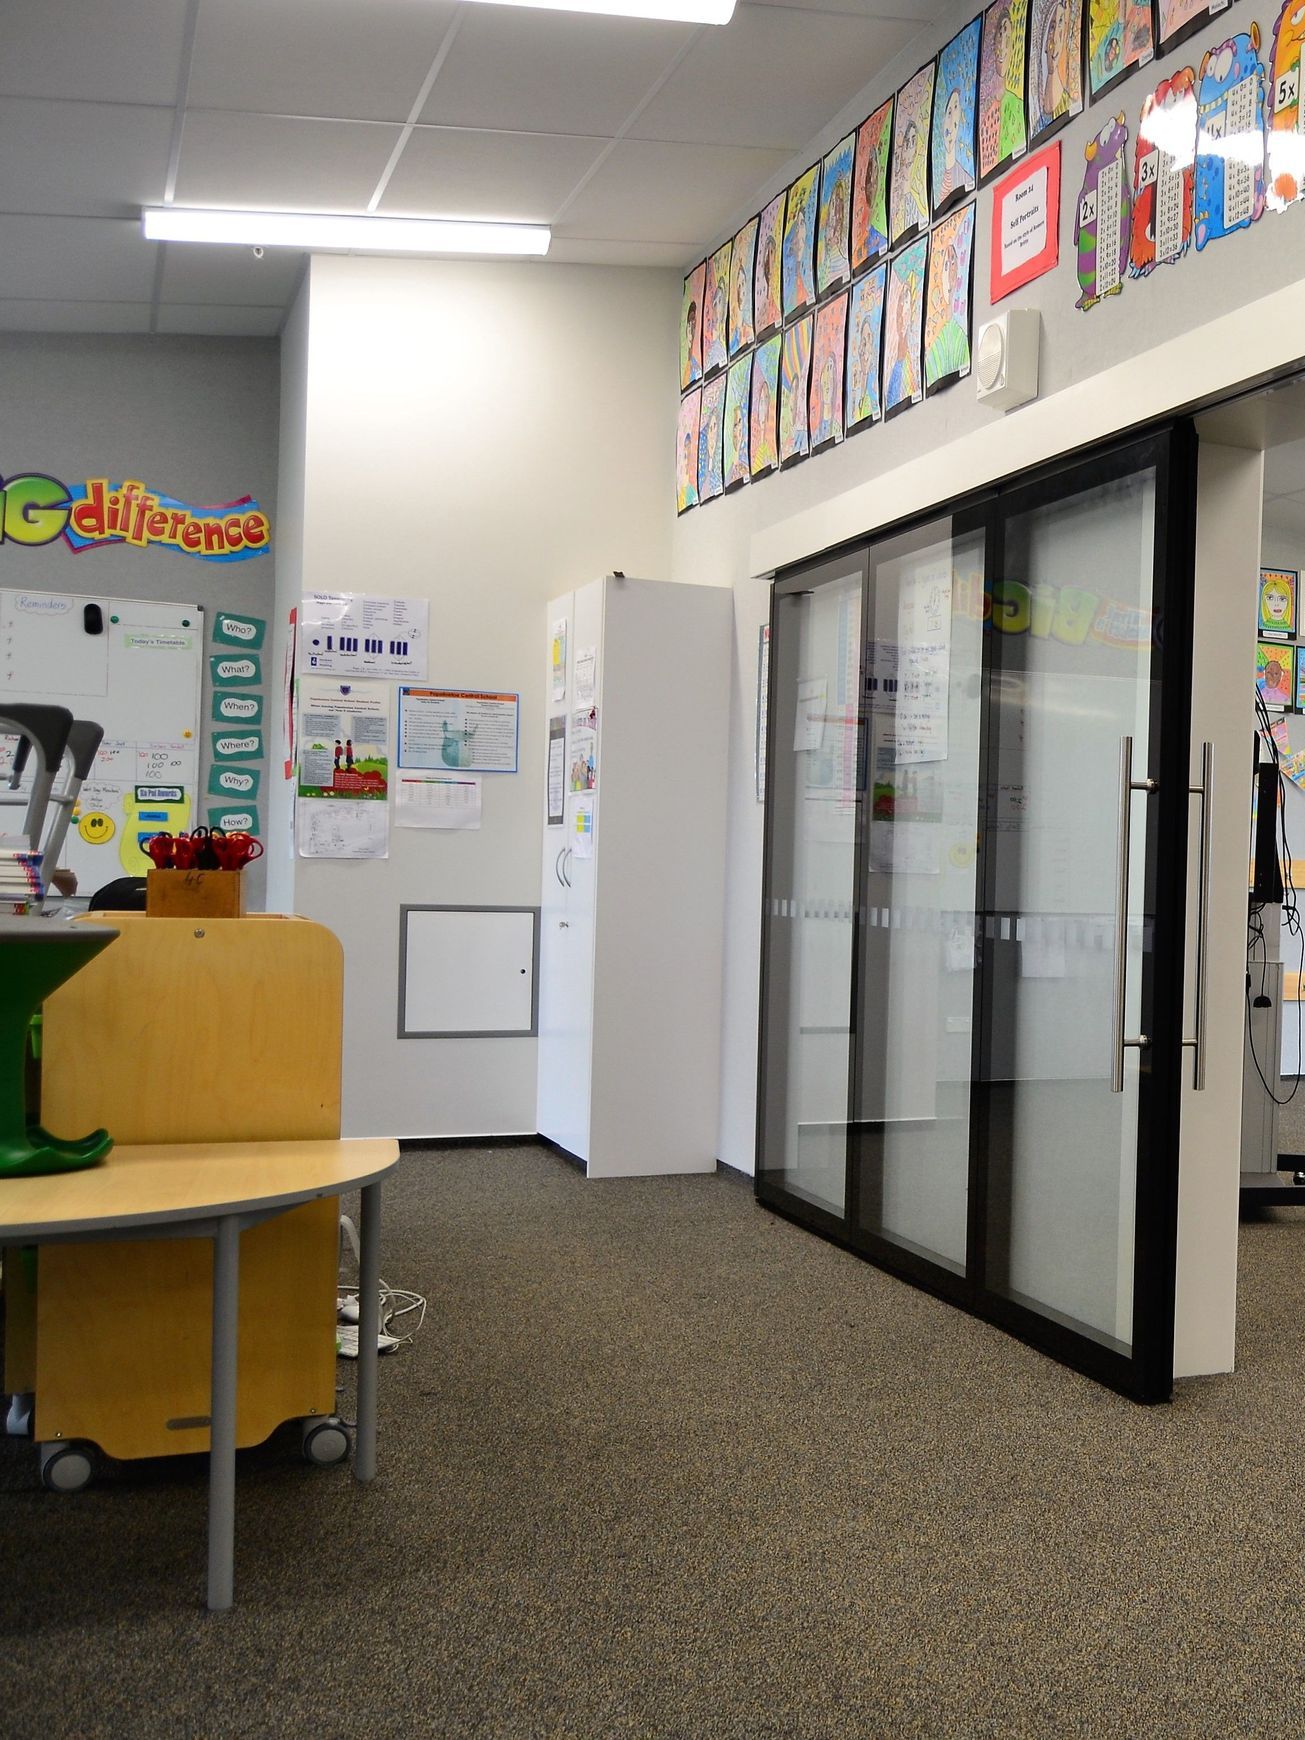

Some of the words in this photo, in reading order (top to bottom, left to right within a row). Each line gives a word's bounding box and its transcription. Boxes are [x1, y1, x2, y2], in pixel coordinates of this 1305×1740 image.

[1278, 80, 1294, 105] 5x
[1141, 162, 1155, 181] 3x
[1015, 189, 1028, 202] Room
[1020, 205, 1039, 225] Portraits
[1082, 202, 1094, 221] 2x
[73, 480, 268, 552] difference
[226, 623, 252, 636] Who?
[221, 665, 250, 674] What?
[223, 702, 255, 712] When?
[221, 740, 255, 750] Where?
[151, 752, 168, 761] 100
[145, 770, 162, 779] 100
[224, 775, 249, 786] Why?
[223, 817, 248, 827] How?
